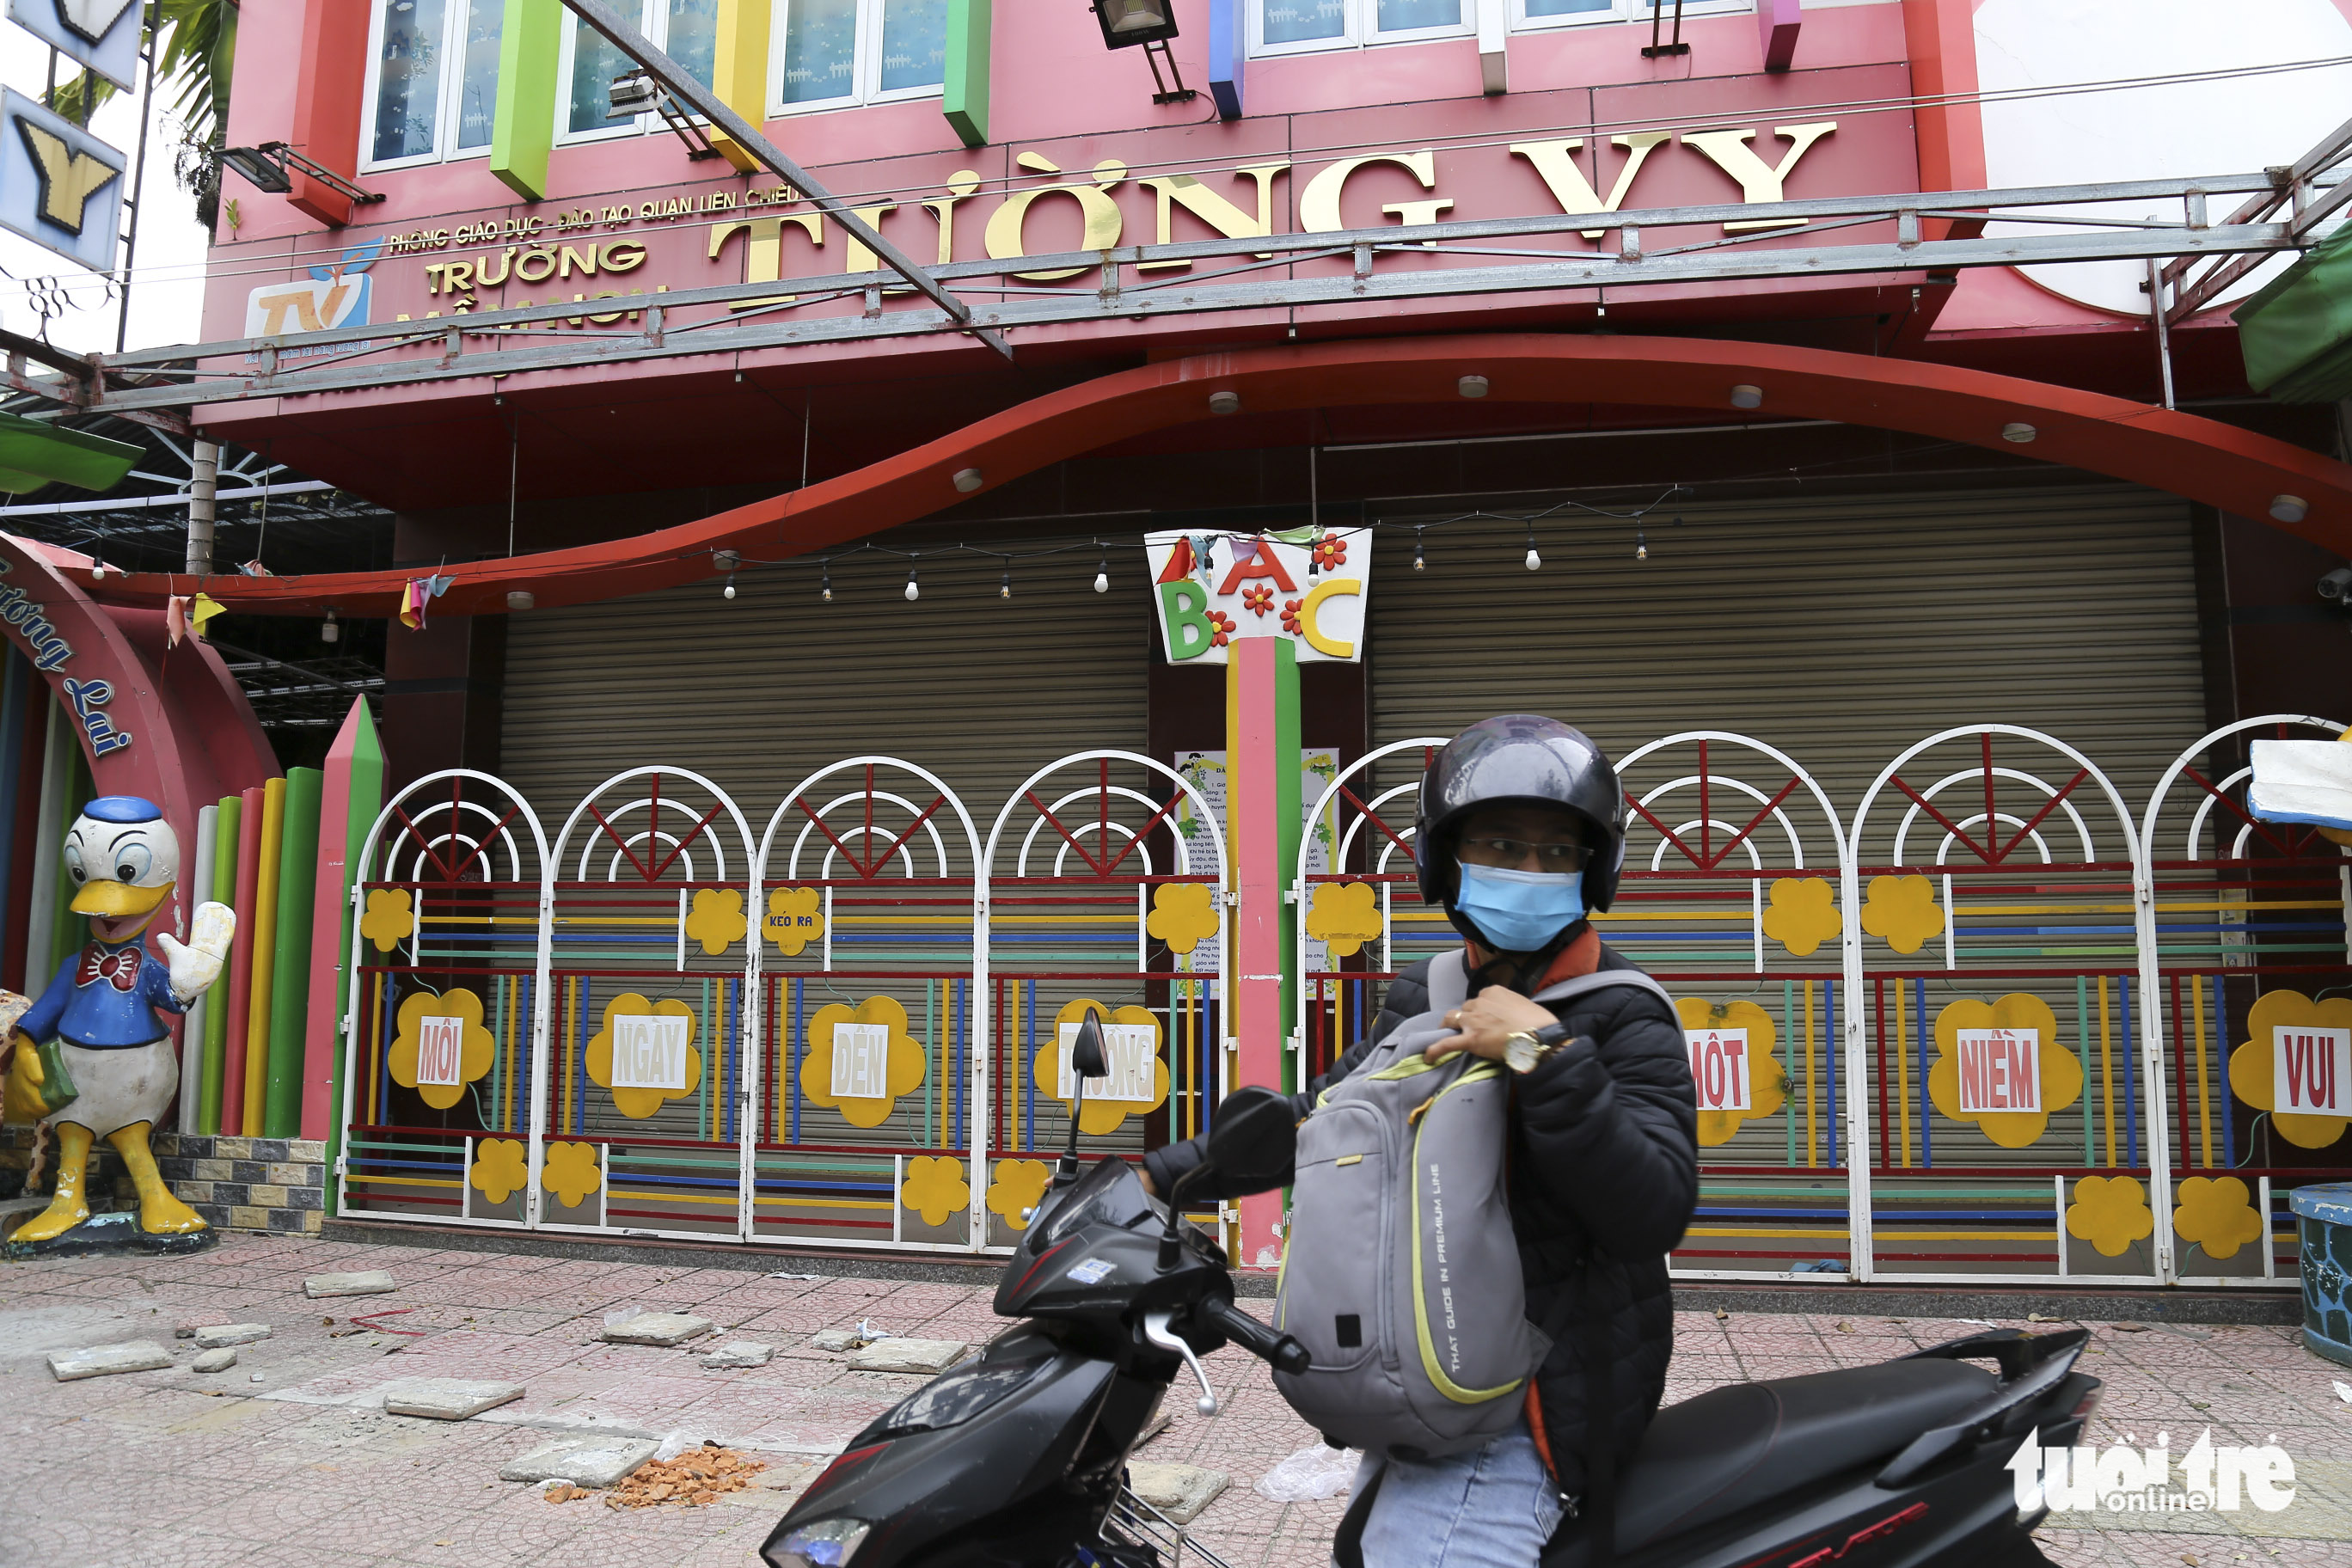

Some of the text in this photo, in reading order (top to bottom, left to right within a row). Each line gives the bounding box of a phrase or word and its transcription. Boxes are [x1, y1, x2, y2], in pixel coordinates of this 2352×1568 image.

[389, 228, 450, 254] PHÒNG
[456, 219, 499, 245] GIÁO
[504, 215, 543, 240] DỤC
[557, 206, 595, 231] ĐÀO
[600, 204, 633, 229] TẠO
[699, 190, 738, 214] LIÊN
[425, 120, 1838, 309] TRƯỜNG TƯỜNG VY
[1161, 579, 1361, 660] B C
[64, 677, 132, 757] Lai
[769, 910, 812, 927] KÉO RA
[617, 1017, 682, 1082] NGÀY
[1060, 1025, 1153, 1099] TỜNG
[1960, 1029, 2035, 1109] NIỀM
[2283, 1034, 2336, 1109] VUI
[1430, 1163, 1461, 1373] THAT GUIDE IN PREMIUM LINE
